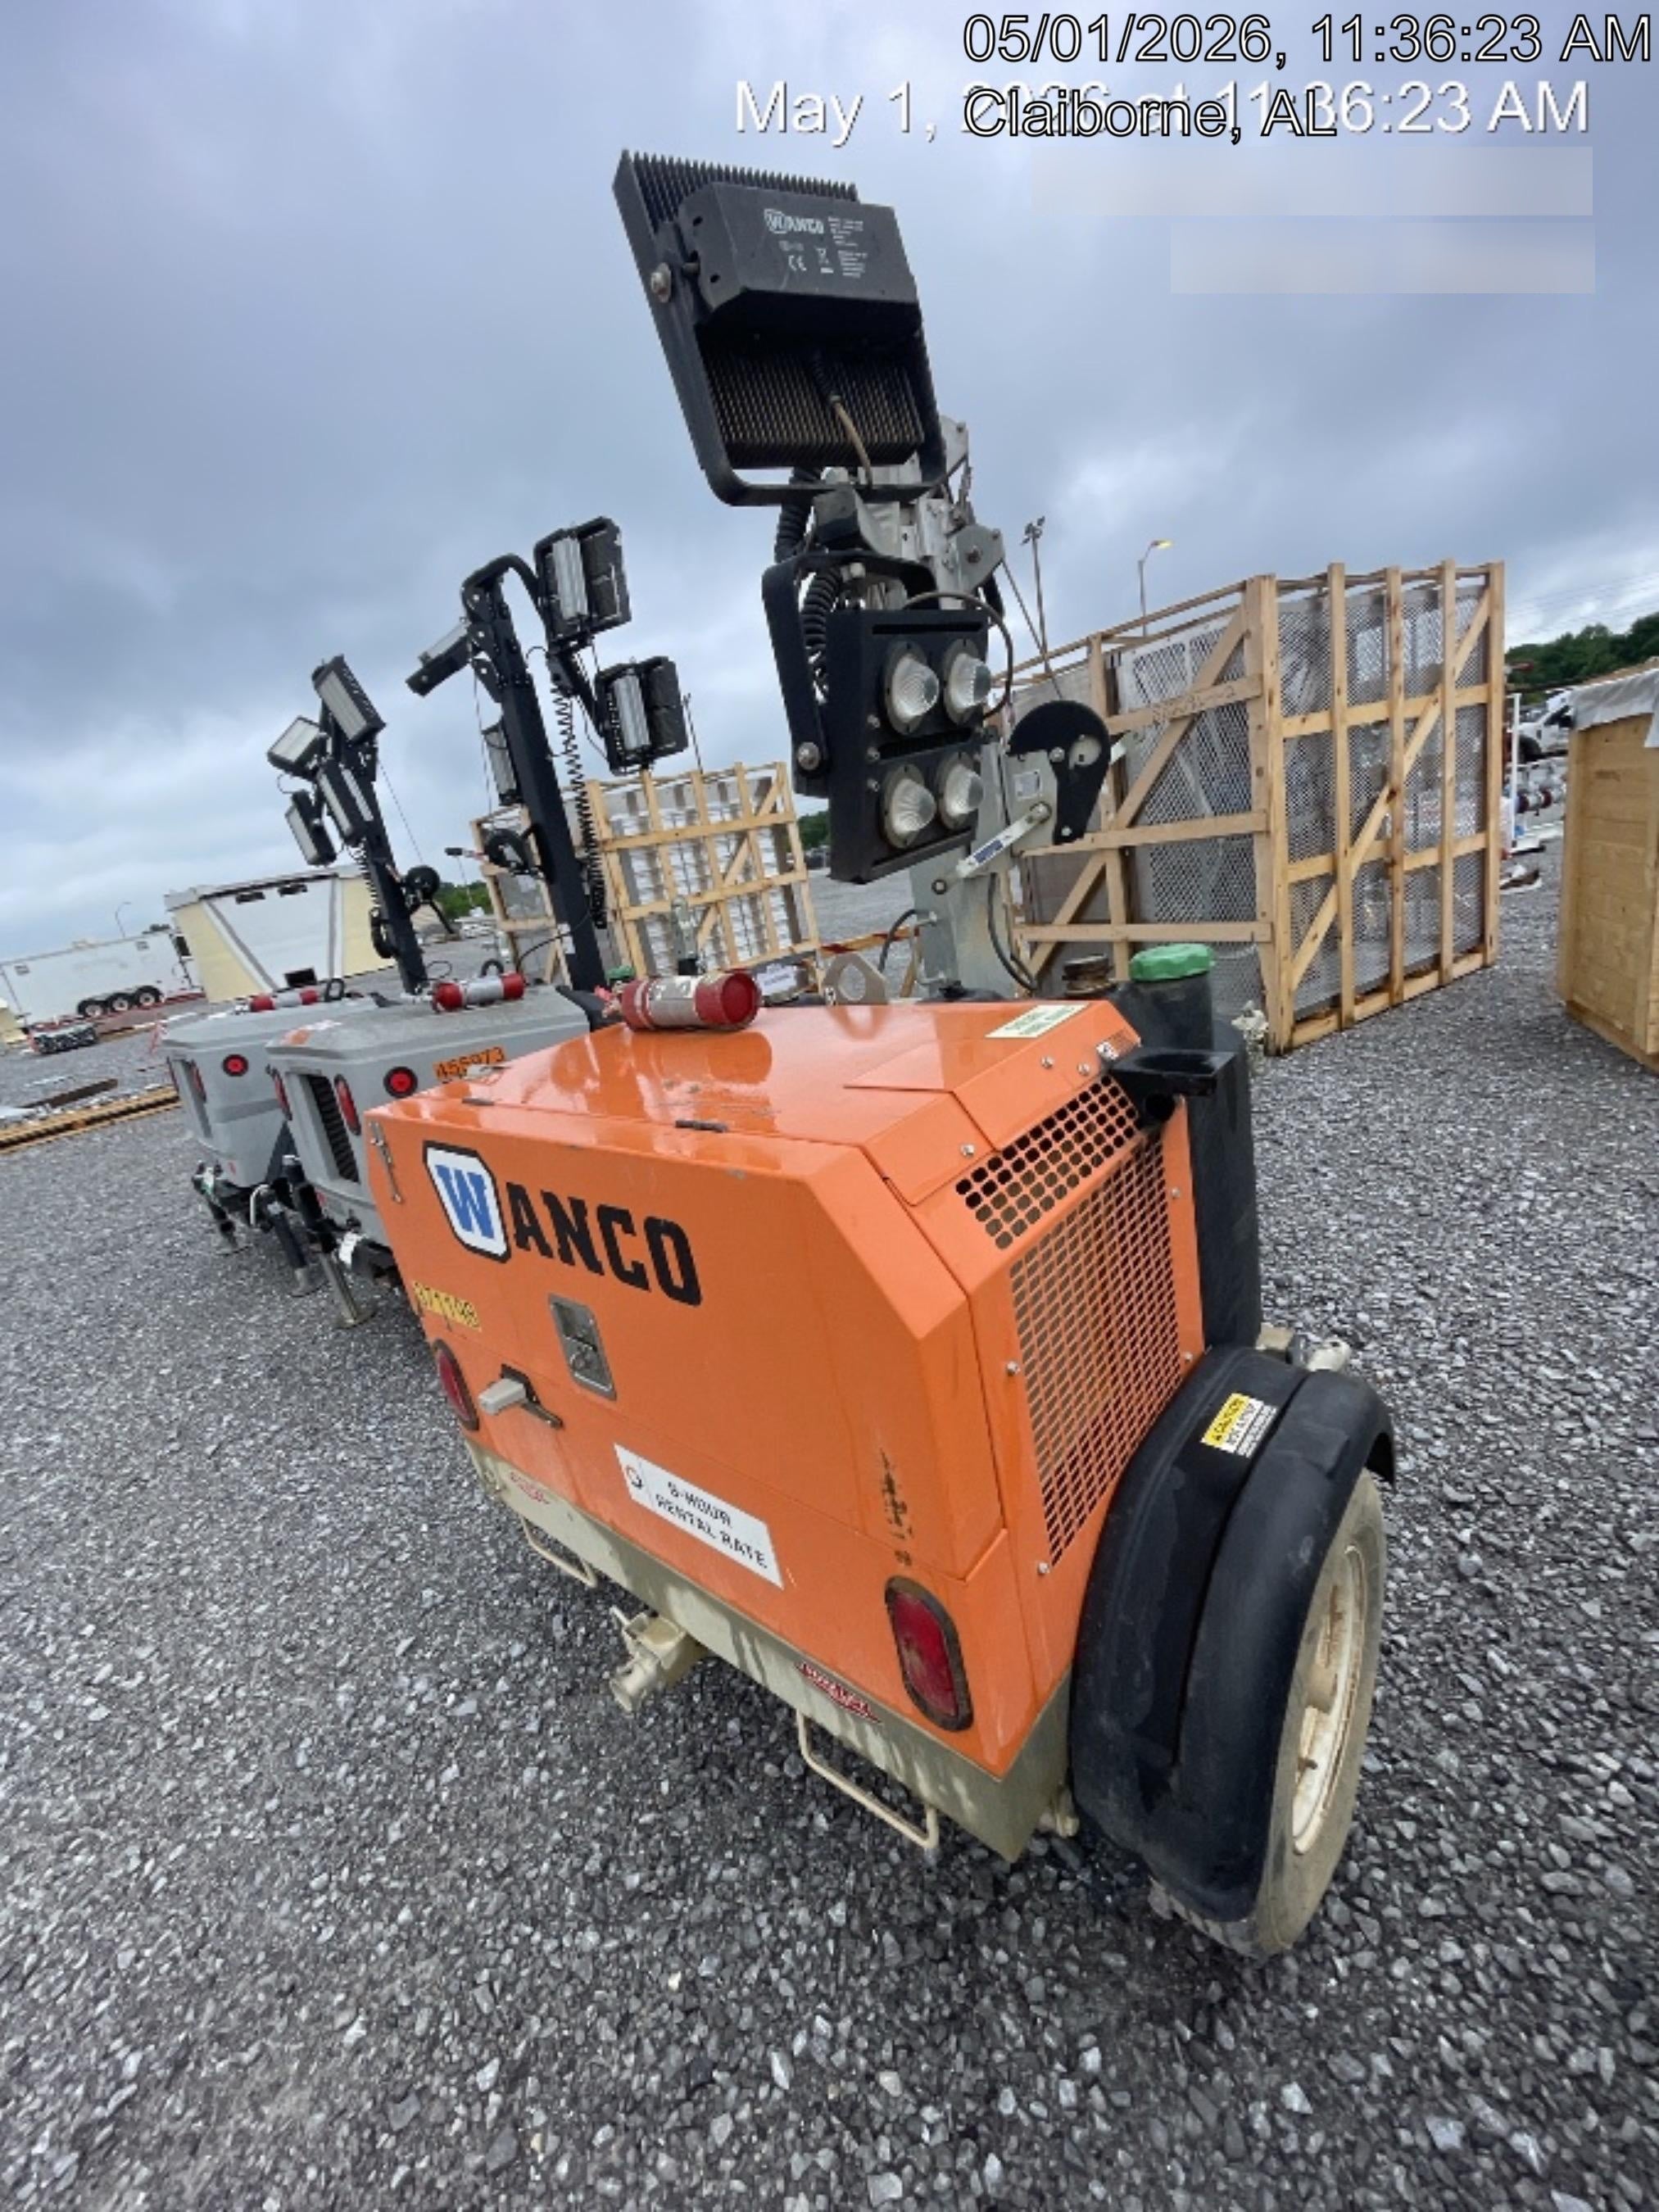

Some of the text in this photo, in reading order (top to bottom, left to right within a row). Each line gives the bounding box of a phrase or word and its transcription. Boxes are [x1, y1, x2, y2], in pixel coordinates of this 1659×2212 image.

[424, 1140, 702, 1307] WANCO
[655, 1493, 768, 1569] RENTAL RATE
[668, 1480, 732, 1527] 8-HOUR
